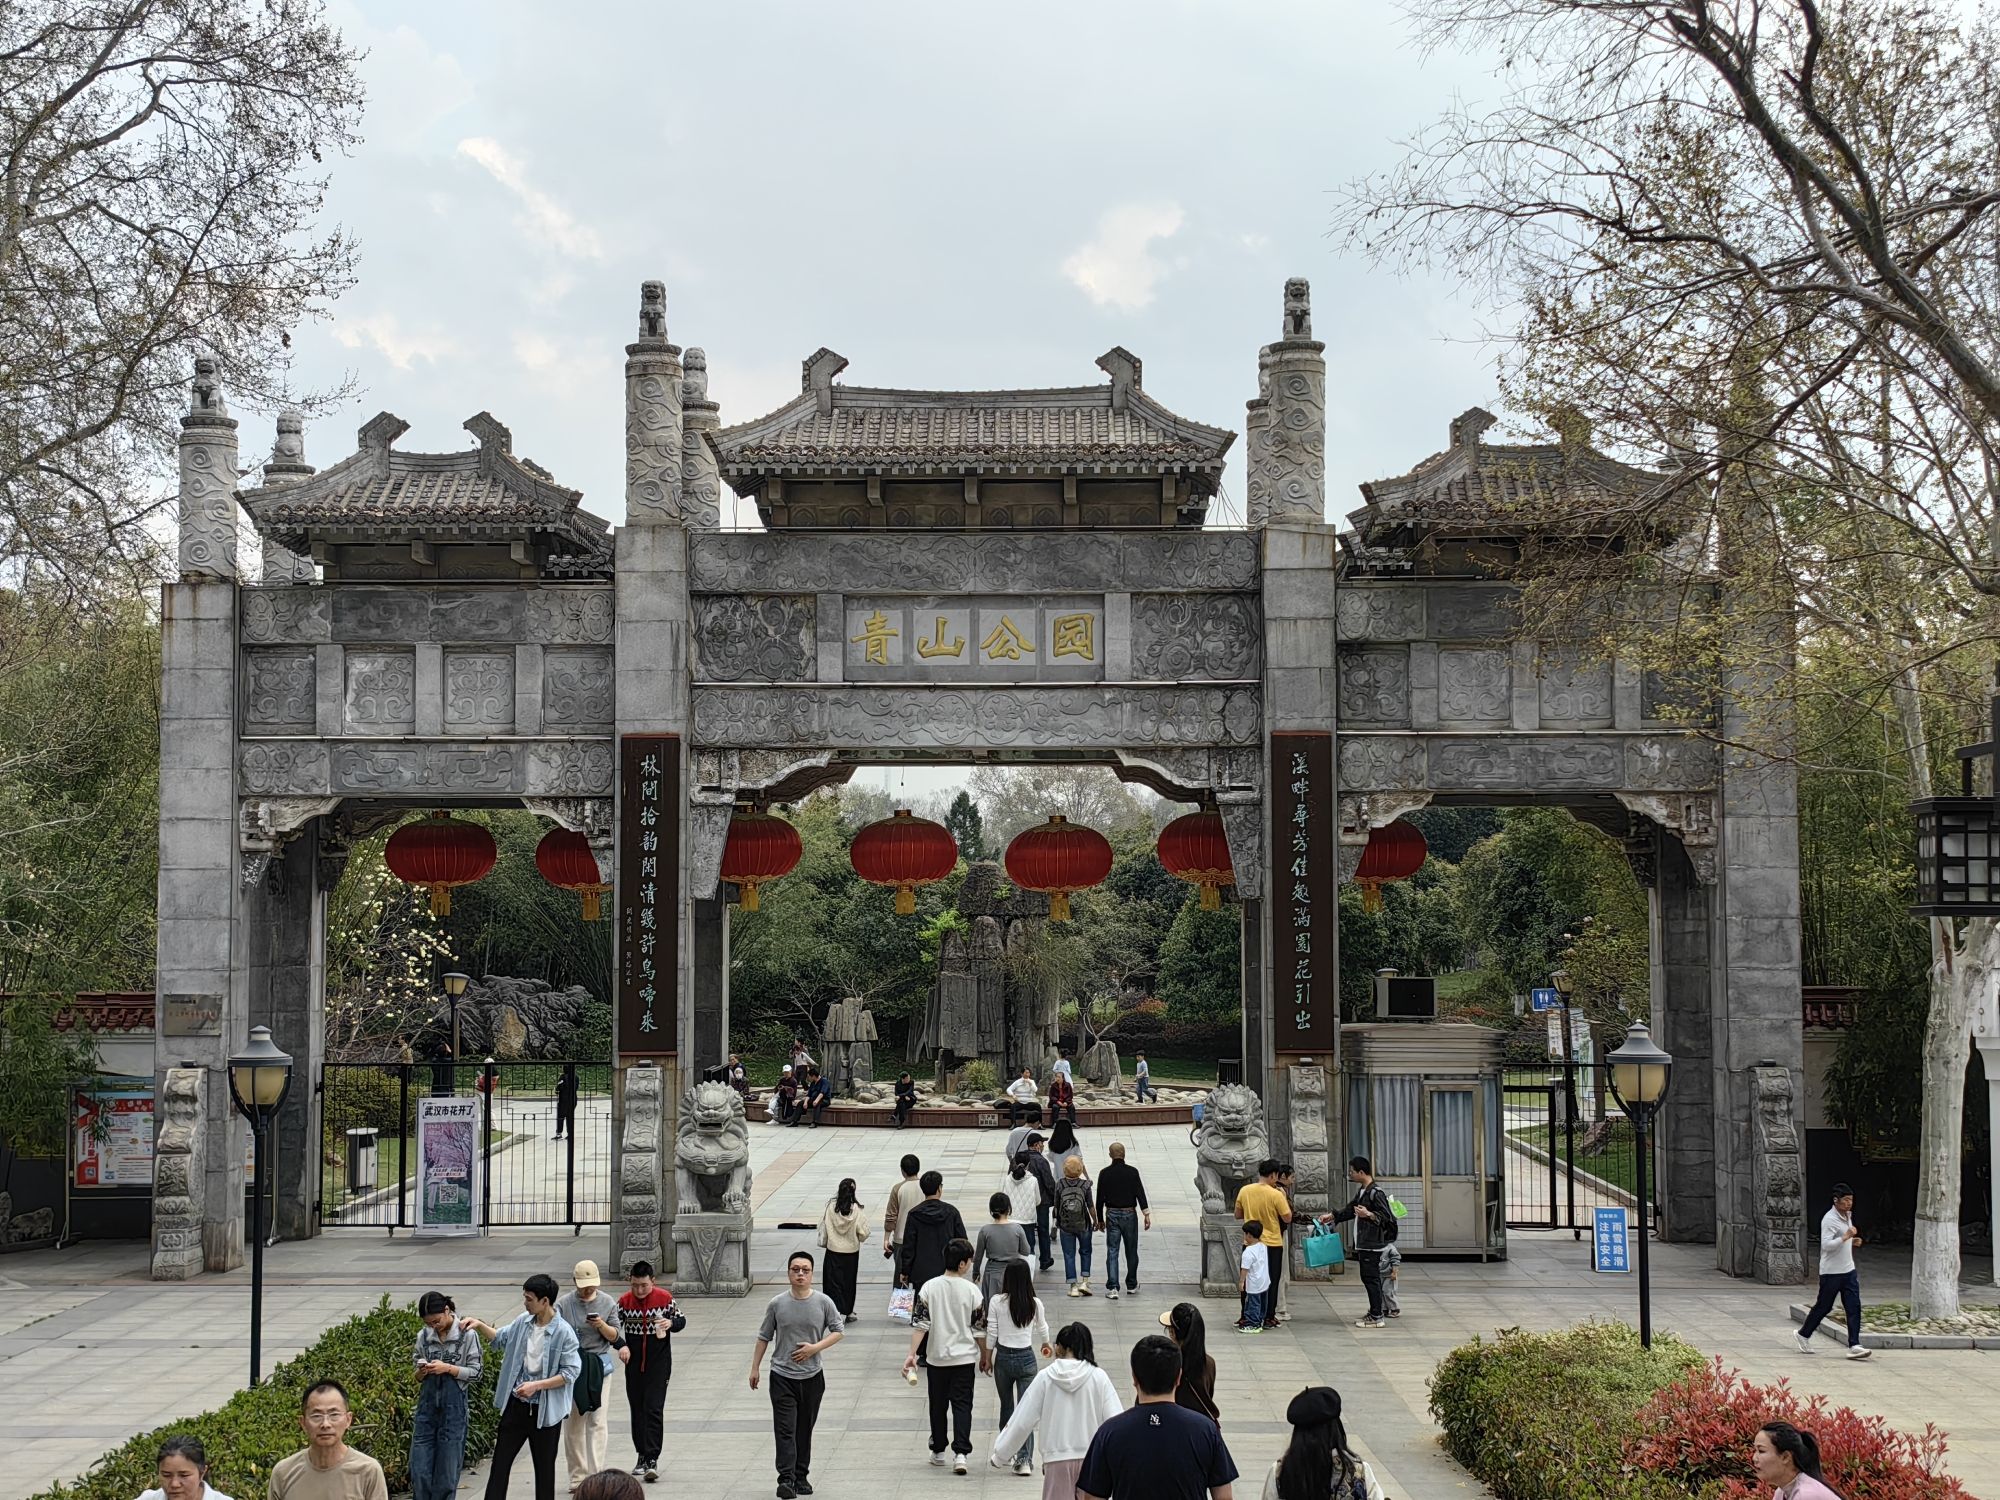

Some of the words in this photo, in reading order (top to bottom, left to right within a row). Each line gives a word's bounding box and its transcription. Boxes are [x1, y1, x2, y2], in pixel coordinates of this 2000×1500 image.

[851, 609, 1095, 665] 青山公园
[425, 1105, 473, 1116] 武汉市花开了
[1599, 1222, 1611, 1267] 注意安全
